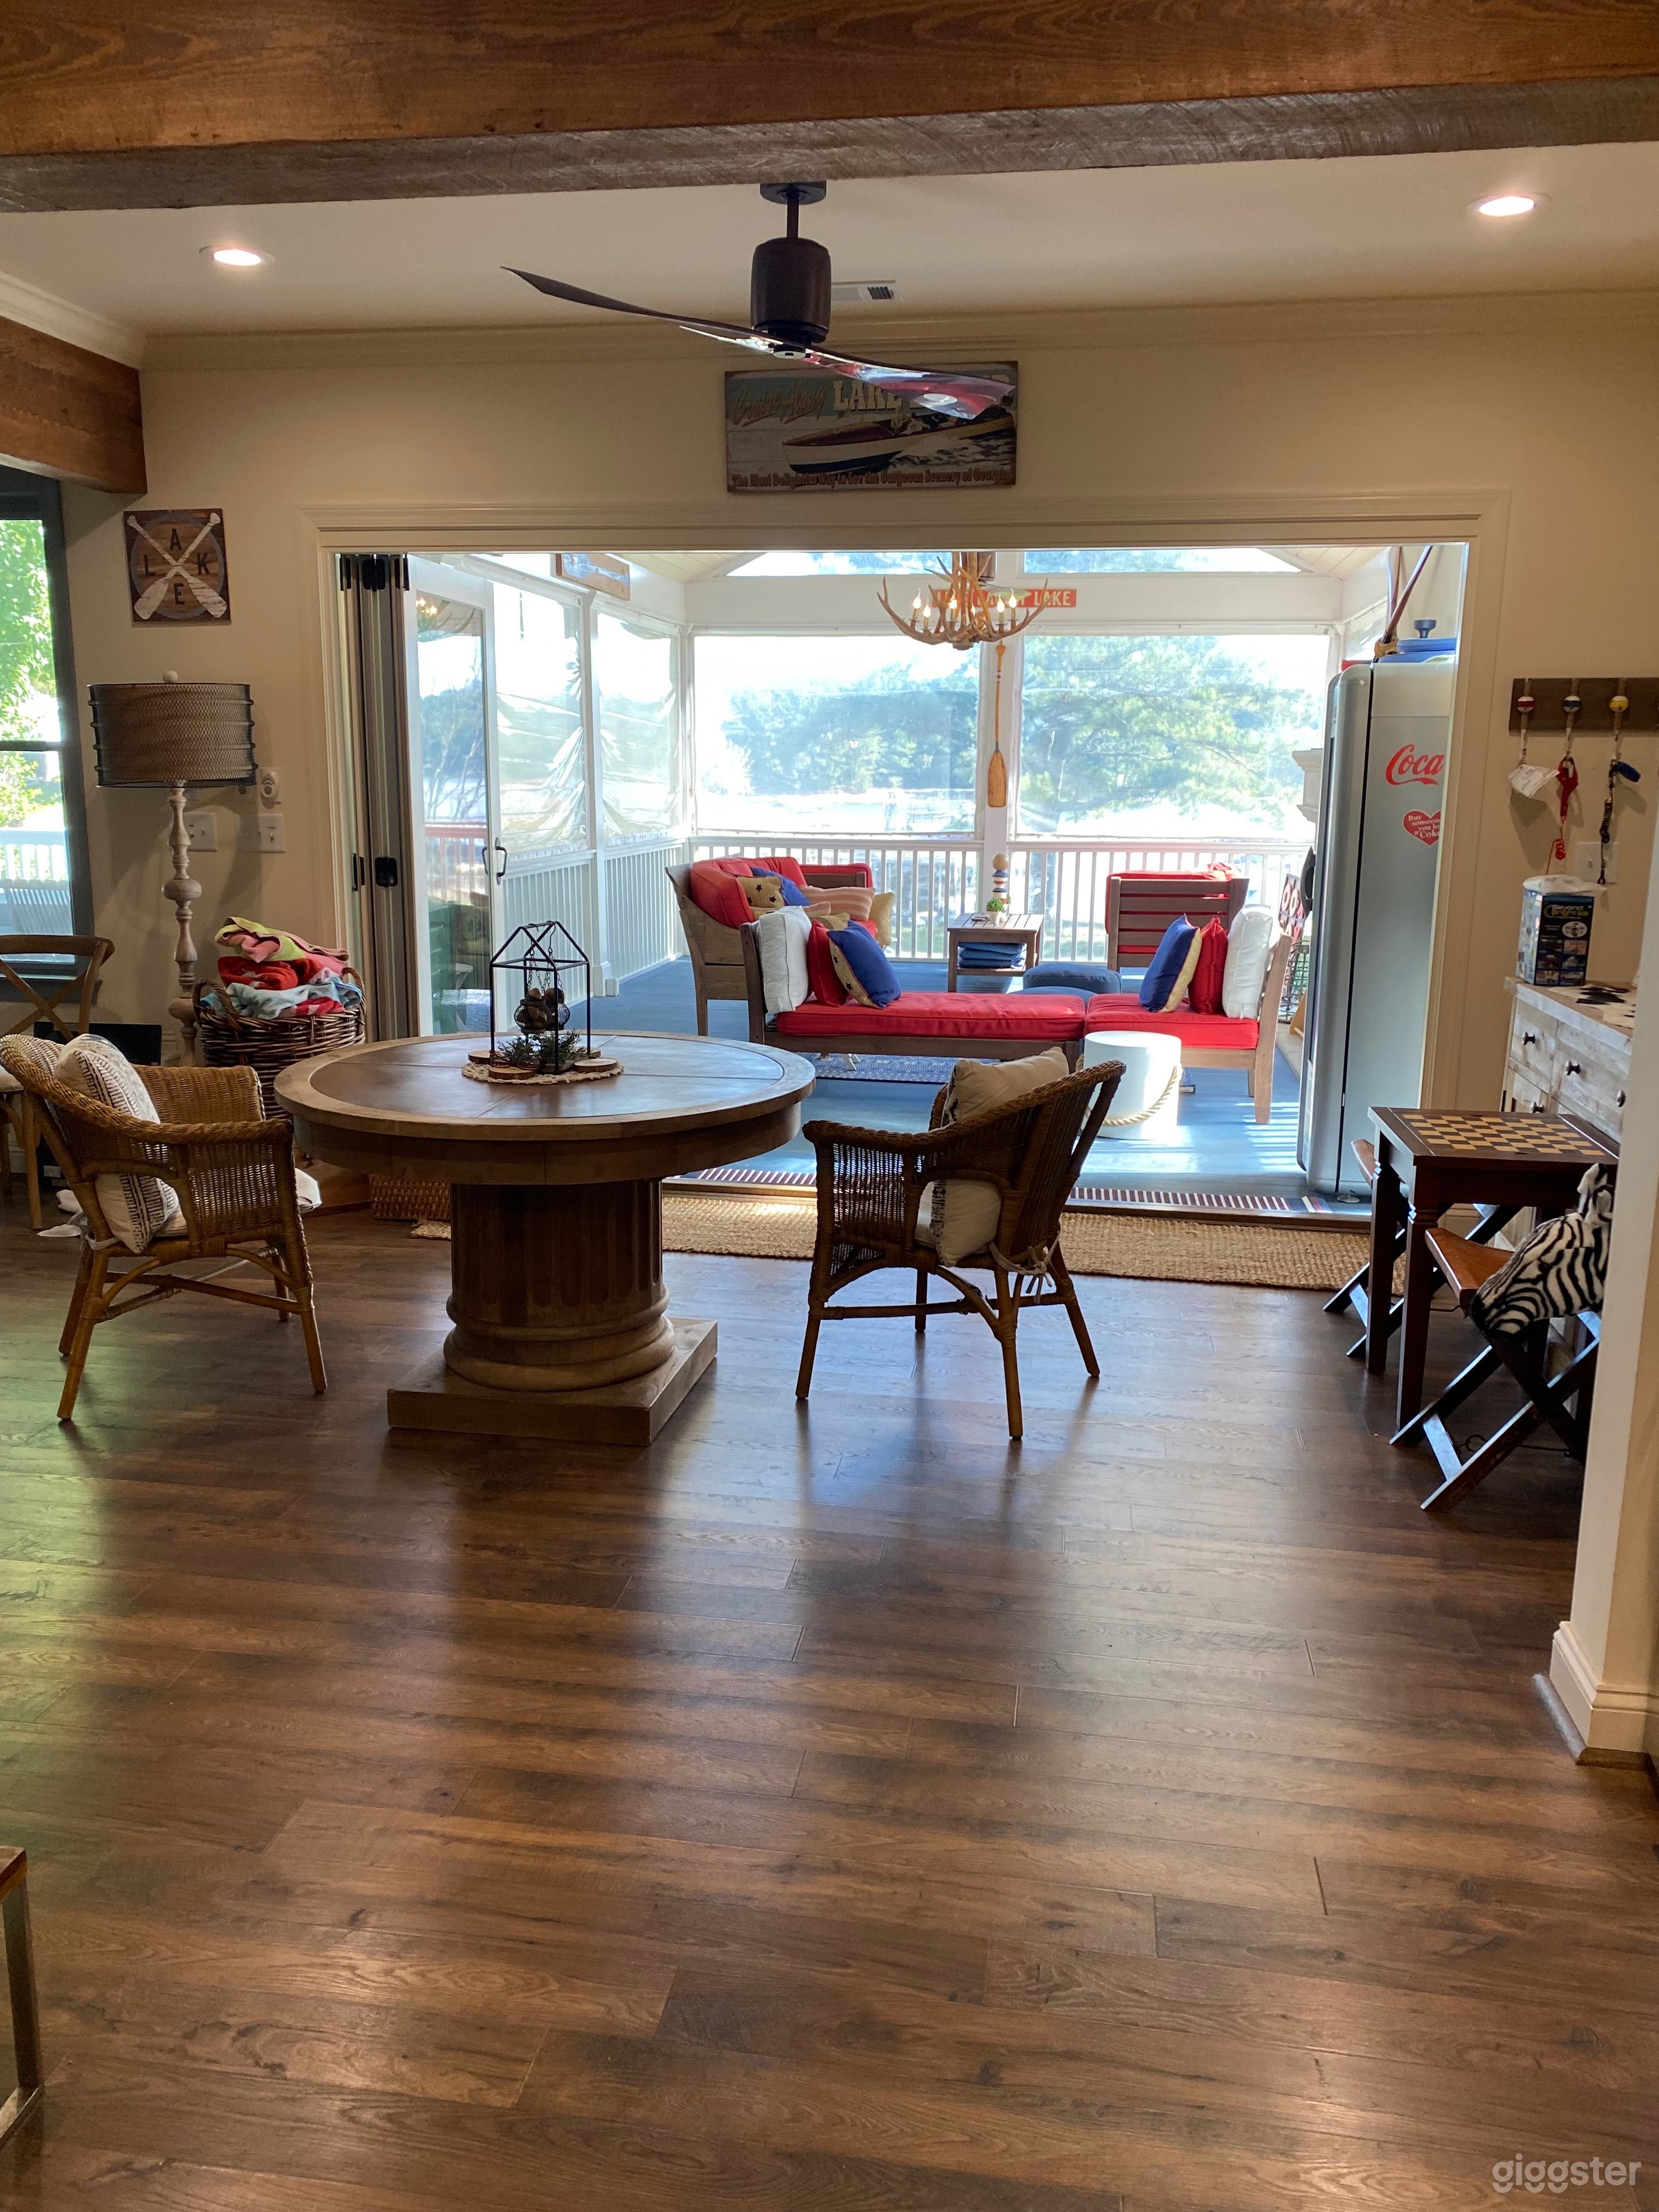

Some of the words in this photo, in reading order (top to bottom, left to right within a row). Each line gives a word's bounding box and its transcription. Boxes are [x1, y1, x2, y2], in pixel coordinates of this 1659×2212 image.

[732, 474, 748, 487] The
[749, 473, 771, 487] Most
[819, 472, 835, 488] Way
[837, 474, 847, 484] to
[848, 470, 863, 485] See
[865, 469, 880, 484] the
[881, 470, 923, 486] Gorgeous
[925, 469, 961, 485] Scenery
[962, 468, 972, 482] of
[1034, 591, 1071, 606] LAKE
